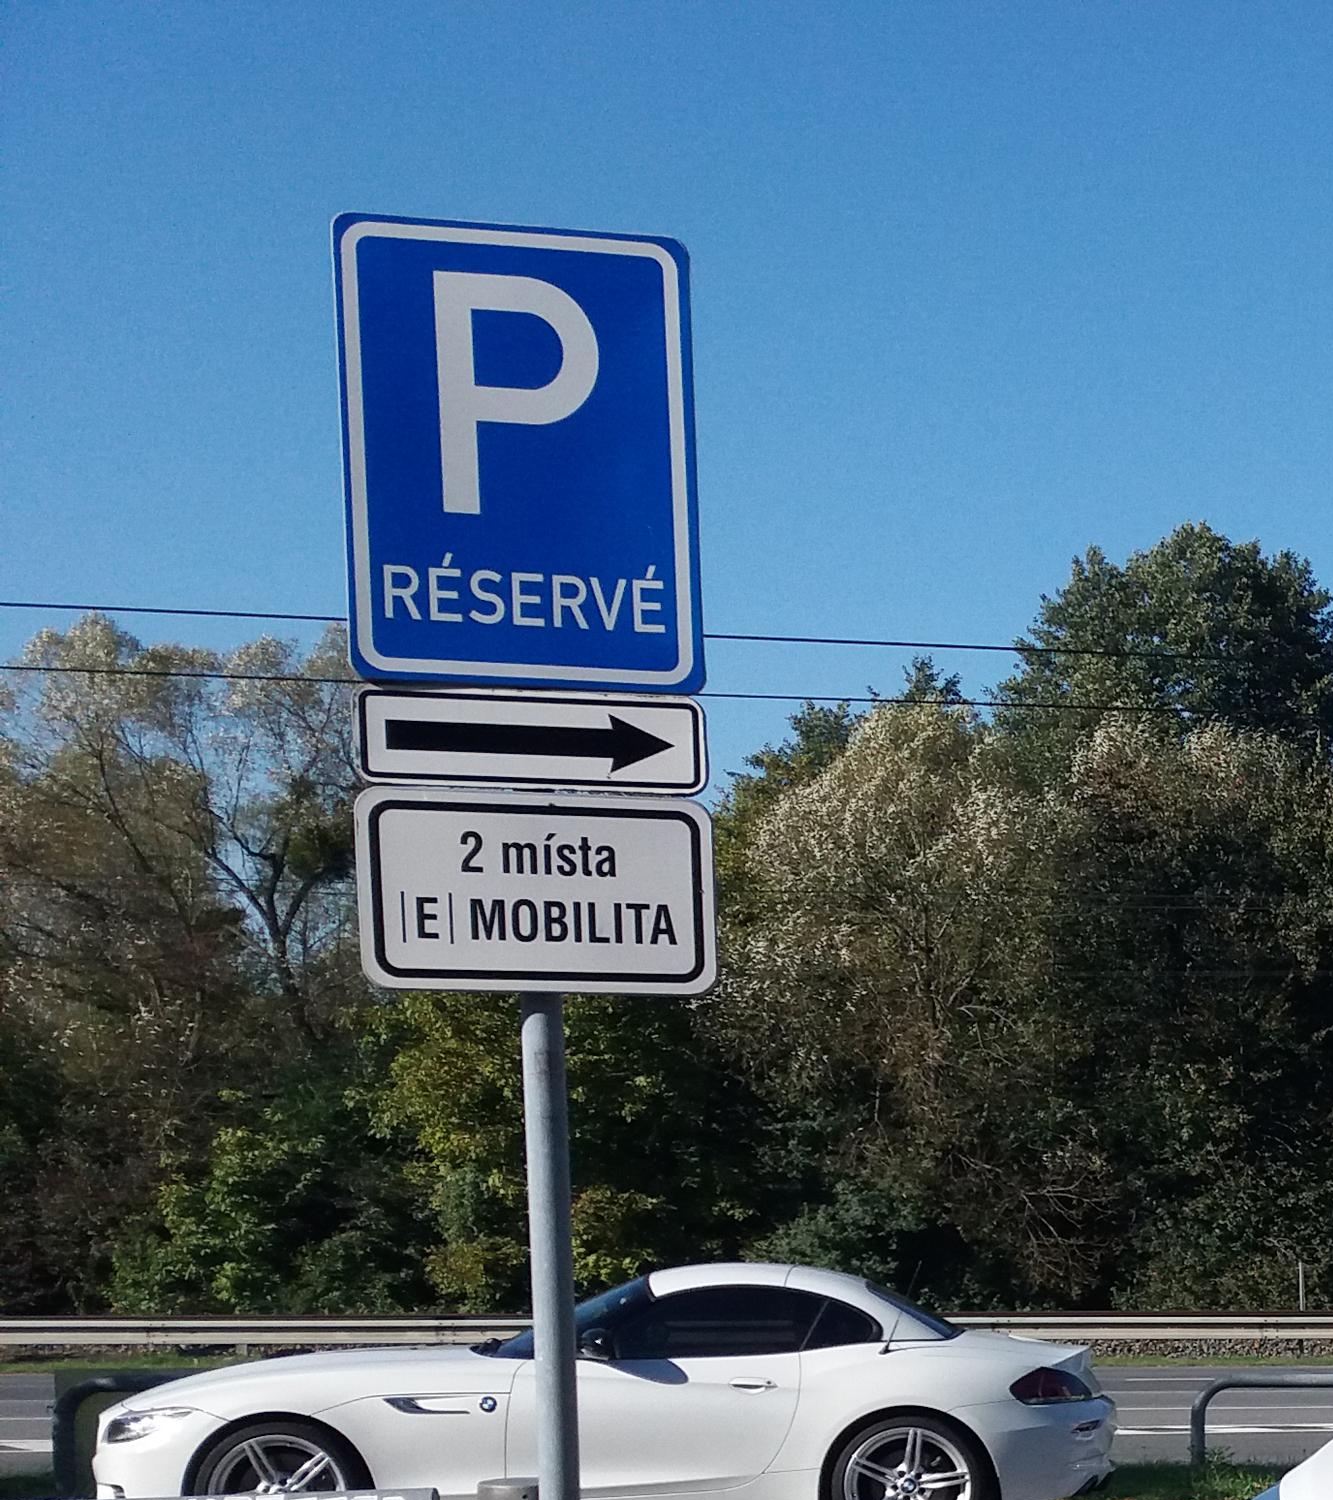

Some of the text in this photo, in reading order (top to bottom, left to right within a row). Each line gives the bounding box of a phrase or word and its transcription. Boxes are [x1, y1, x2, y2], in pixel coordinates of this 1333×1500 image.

[433, 270, 600, 516] P
[382, 551, 667, 634] RÉSERVÉ
[459, 830, 618, 877] 2 místa
[469, 898, 679, 946] MOBILITA
